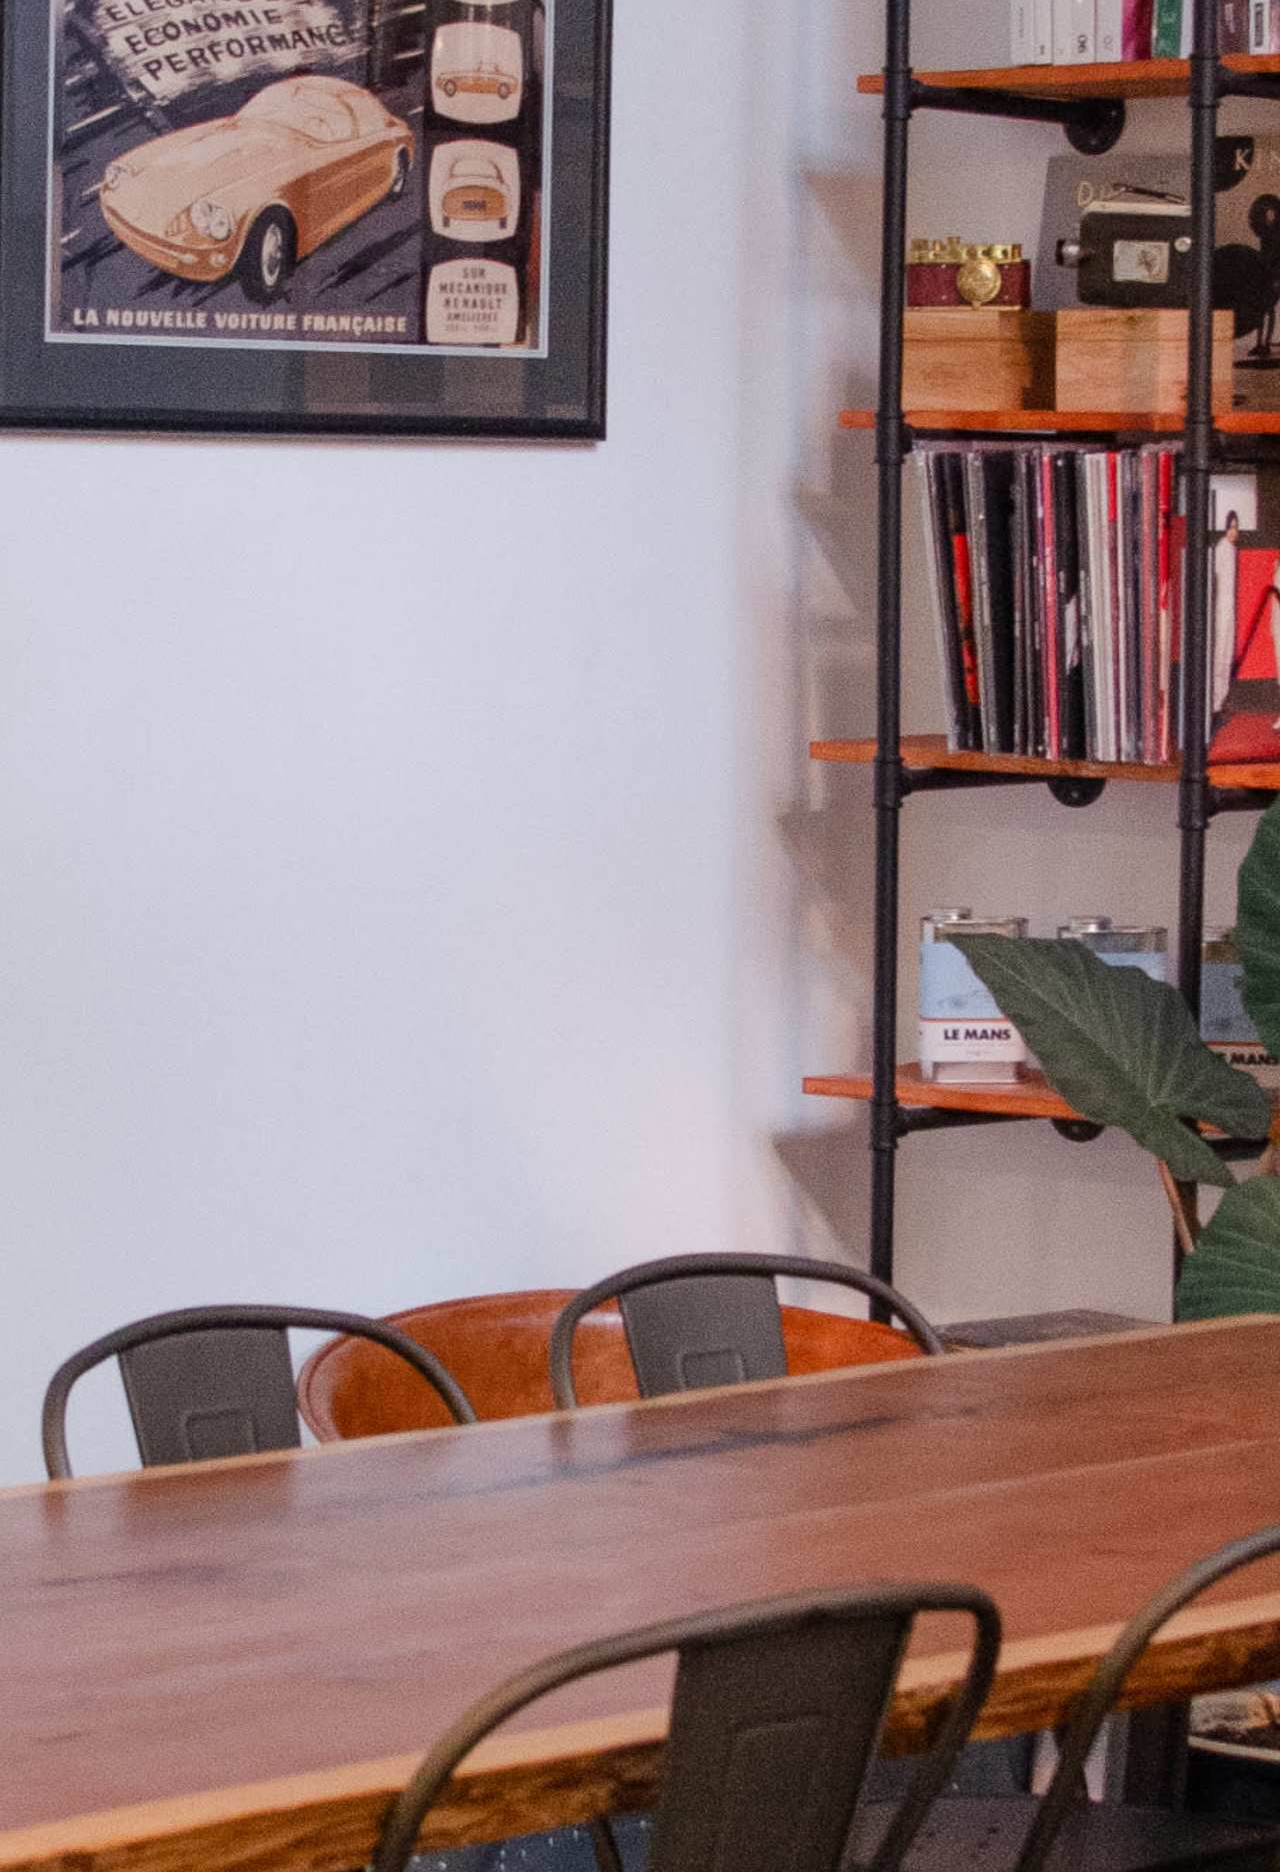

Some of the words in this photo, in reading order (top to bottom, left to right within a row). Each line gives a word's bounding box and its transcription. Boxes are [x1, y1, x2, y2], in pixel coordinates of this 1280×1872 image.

[124, 8, 284, 56] ECONOMIE
[73, 307, 99, 326] LA
[105, 308, 208, 328] NOUVELLE
[214, 312, 297, 330] VOITURE
[302, 314, 407, 336] FRANÇAISE
[943, 1028, 961, 1042] LE
[964, 1028, 1012, 1042] MANS
